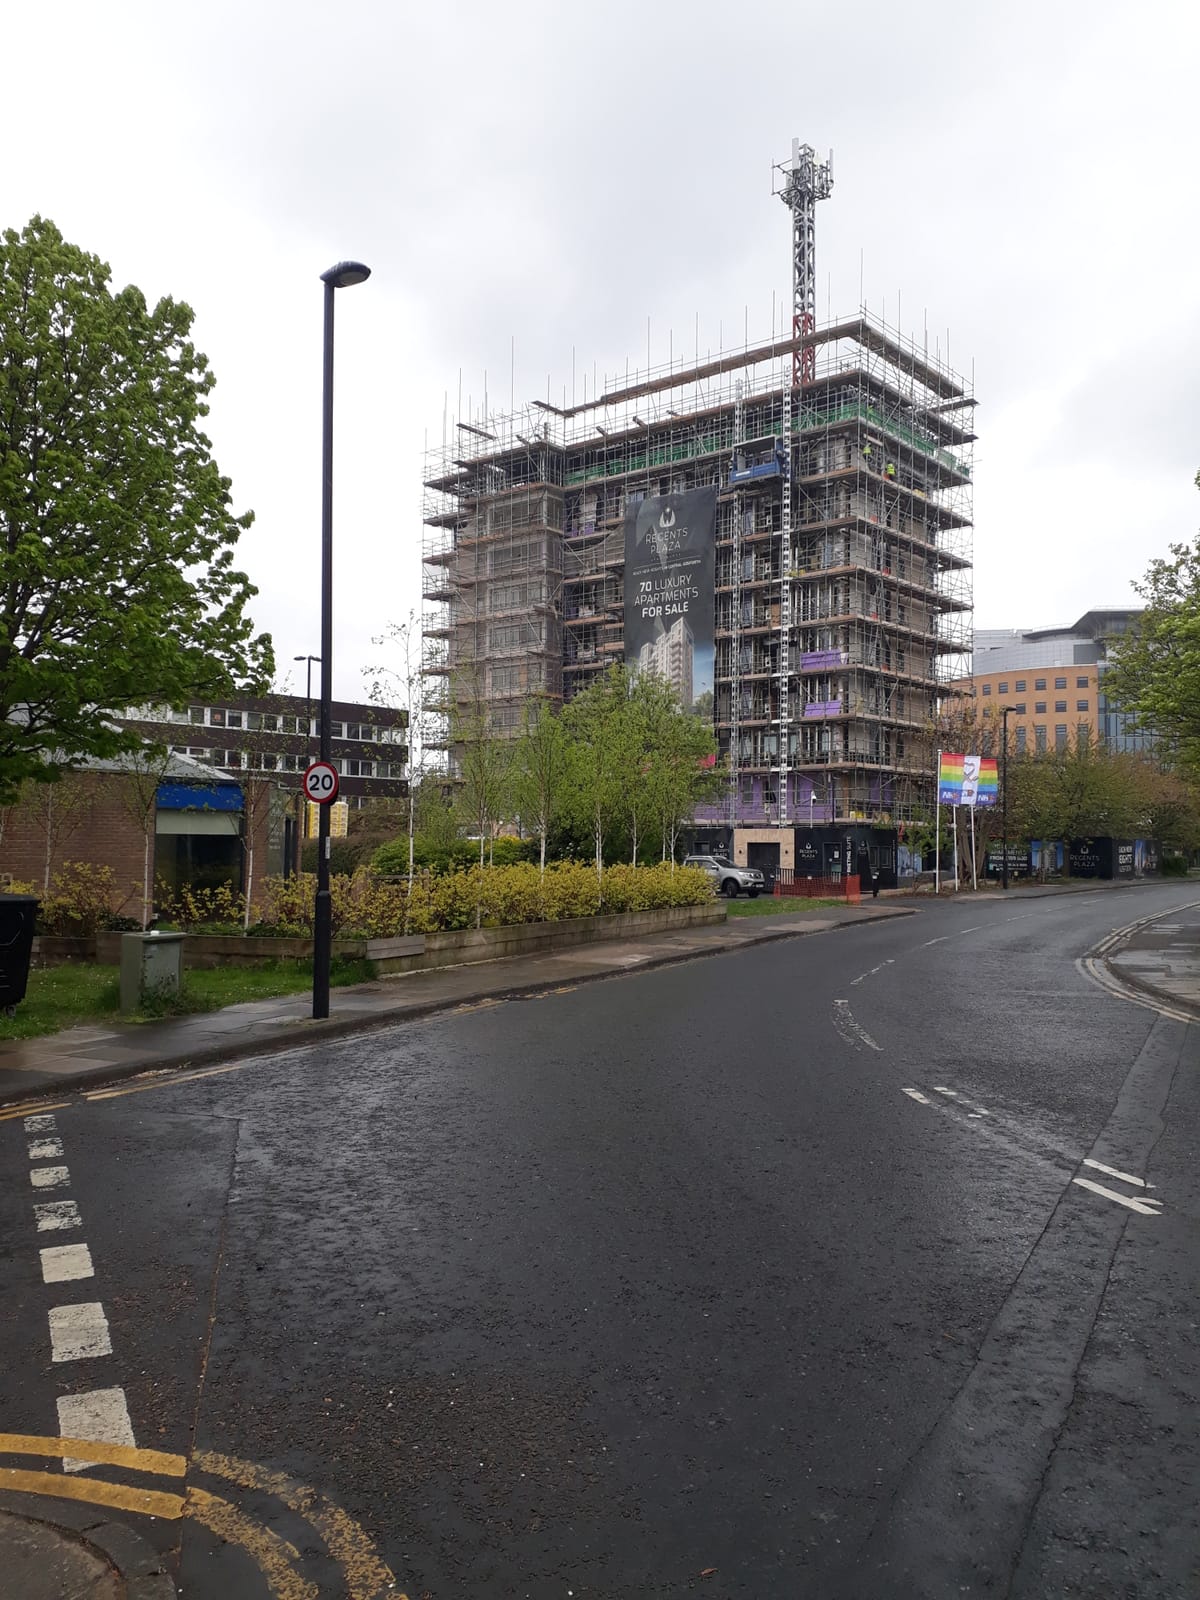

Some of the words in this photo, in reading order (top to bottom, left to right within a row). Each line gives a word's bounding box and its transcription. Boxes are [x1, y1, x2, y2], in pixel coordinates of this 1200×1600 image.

[645, 527, 688, 545] REGENTS
[650, 541, 681, 555] PLAZA
[640, 581, 652, 593] 70
[654, 574, 692, 591] LUXURY
[634, 586, 699, 606] APARTMENTS
[642, 606, 663, 618] FOR
[665, 601, 689, 615] SALE
[309, 774, 333, 791] 20
[1069, 854, 1100, 862] REGENTS
